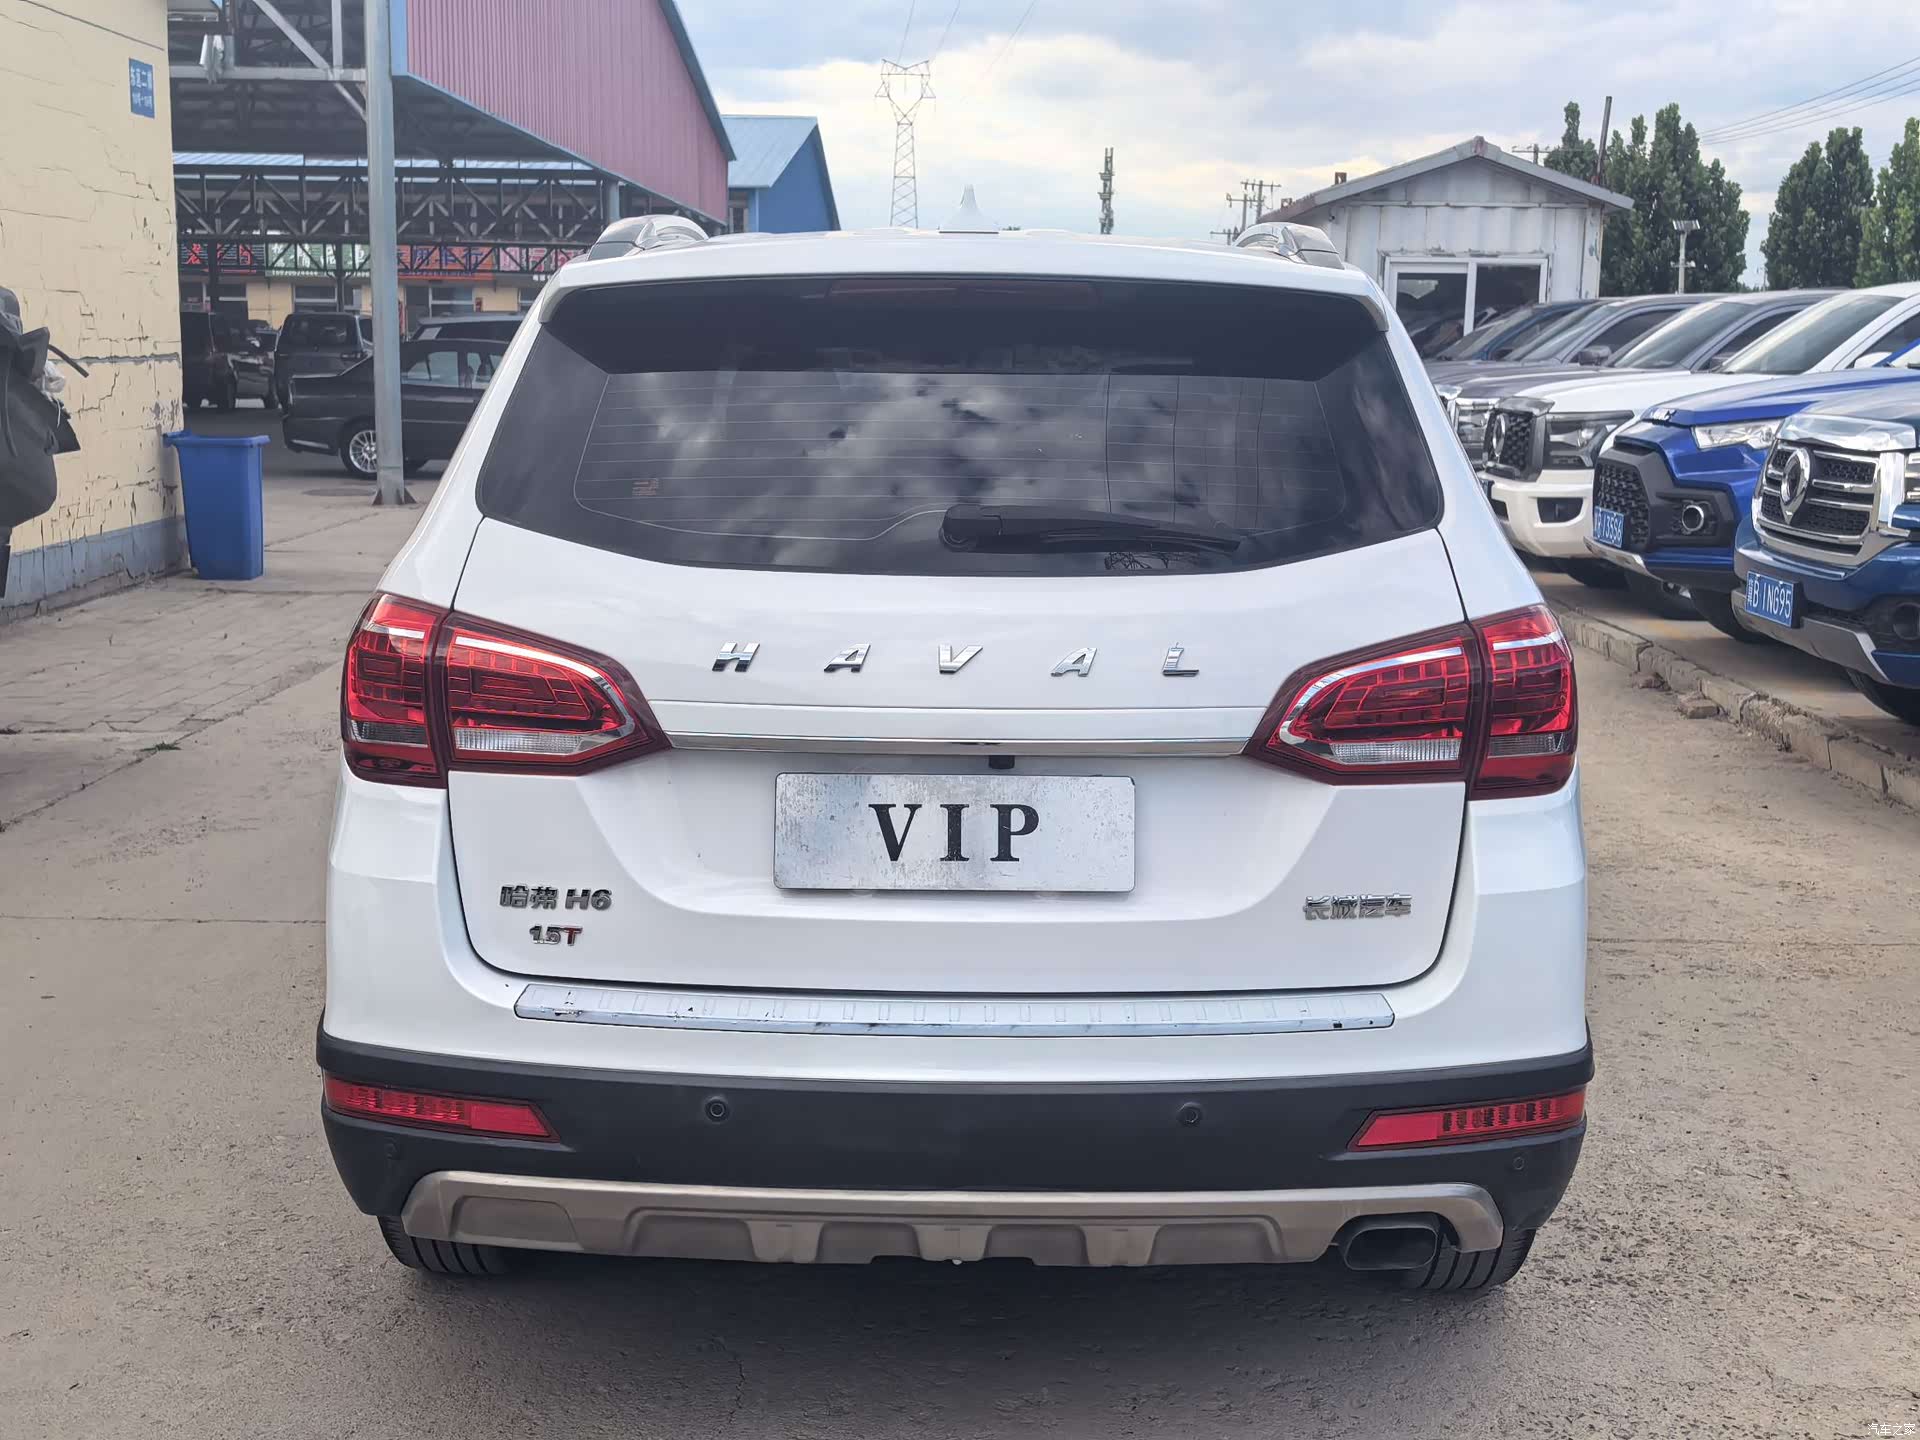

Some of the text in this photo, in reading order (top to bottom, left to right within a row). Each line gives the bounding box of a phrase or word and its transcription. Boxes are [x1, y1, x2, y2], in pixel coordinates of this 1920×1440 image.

[711, 641, 1200, 677] HAVAL
[868, 803, 1039, 863] VIP
[564, 888, 612, 910] H6
[1302, 893, 1412, 920] 长城汽车
